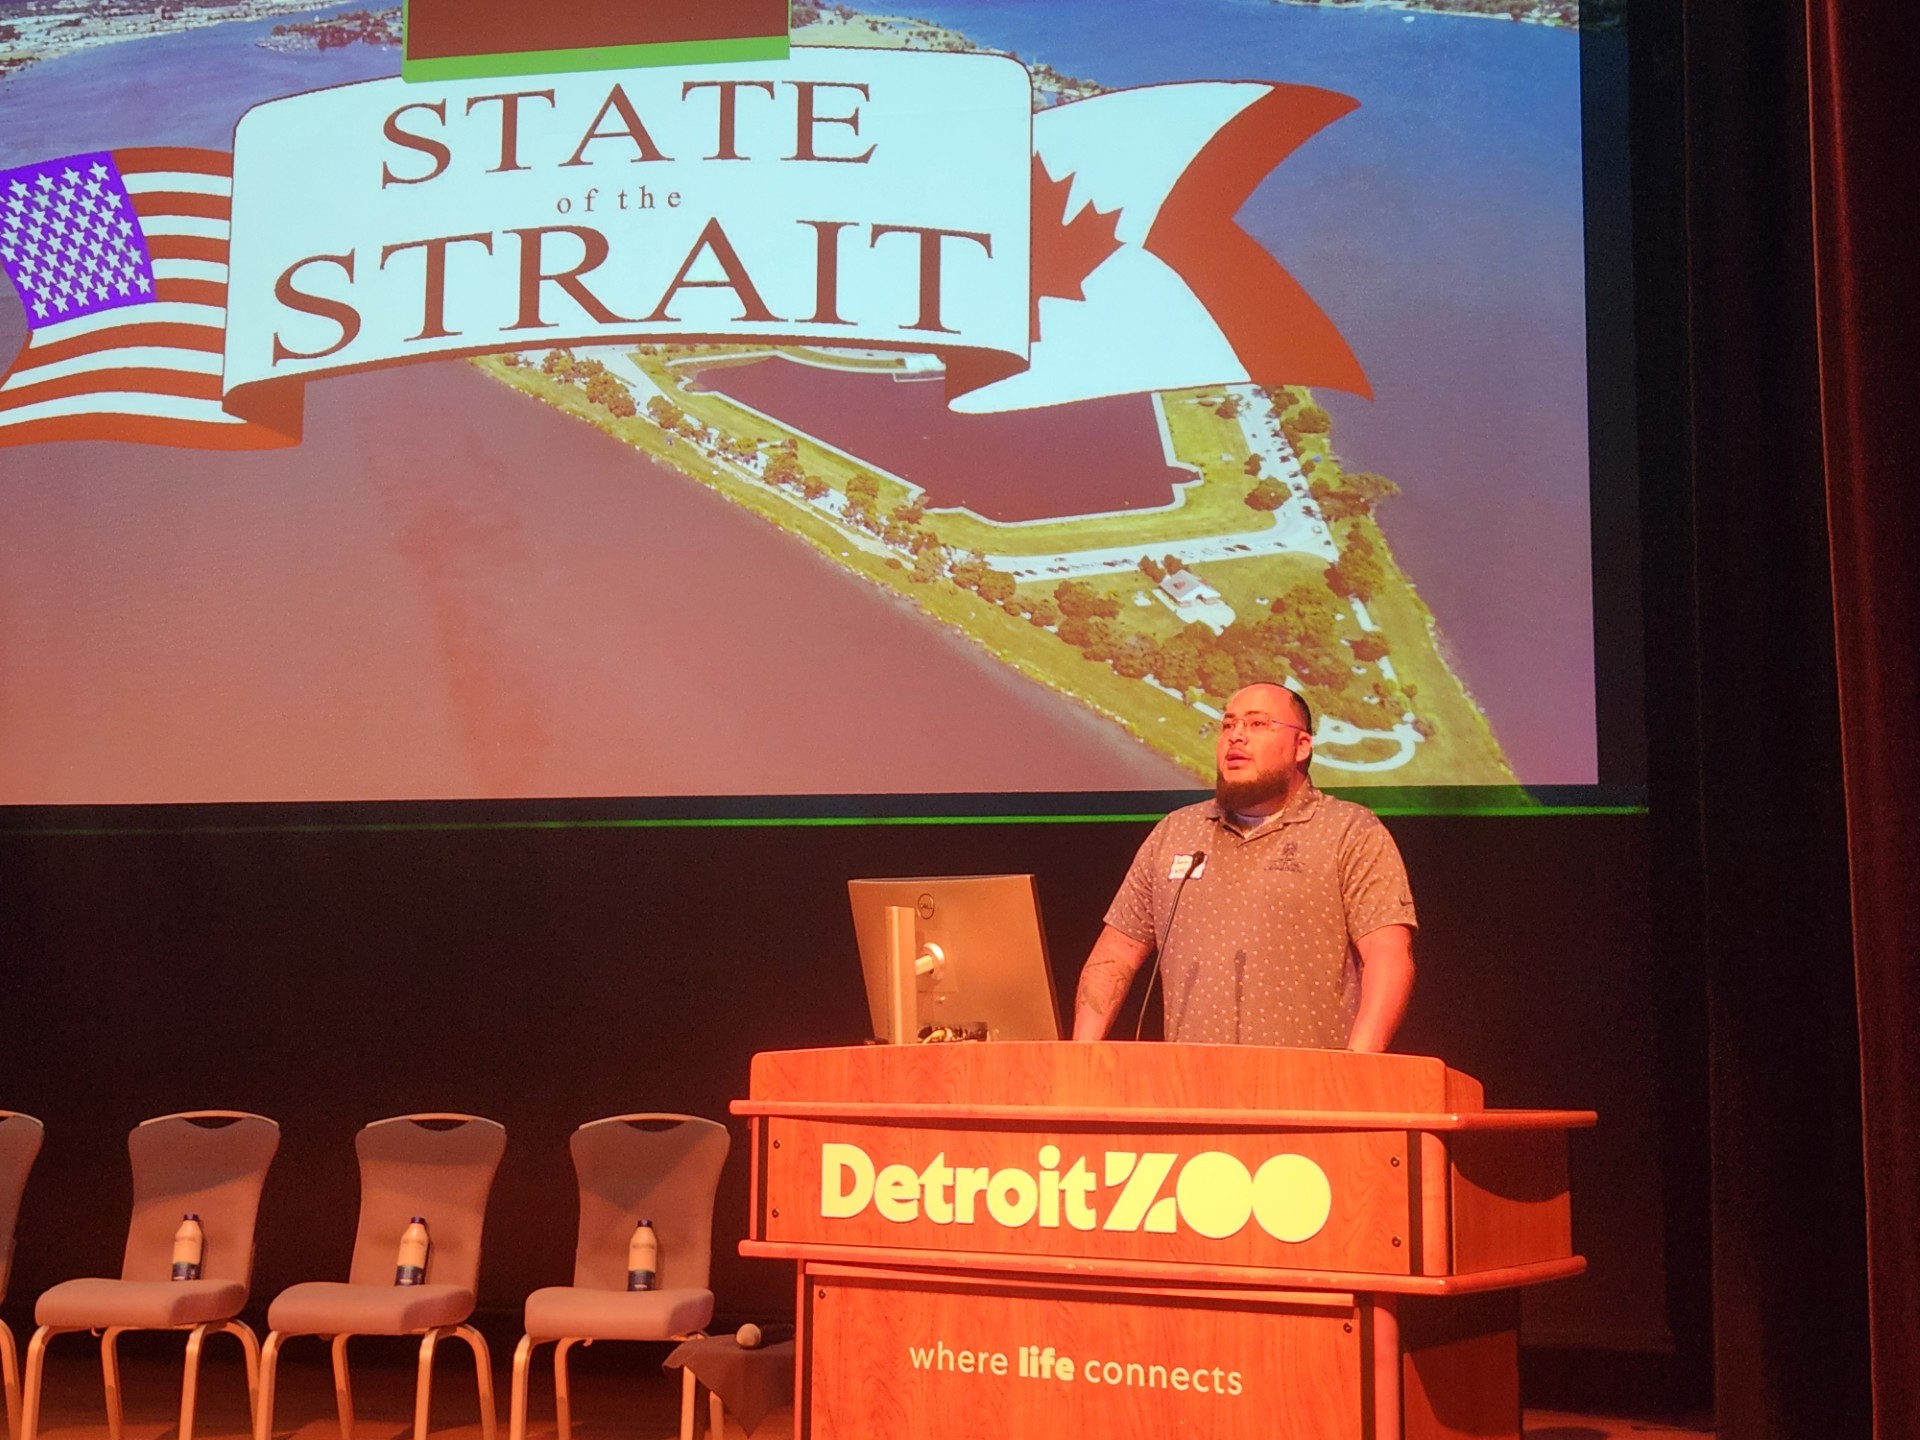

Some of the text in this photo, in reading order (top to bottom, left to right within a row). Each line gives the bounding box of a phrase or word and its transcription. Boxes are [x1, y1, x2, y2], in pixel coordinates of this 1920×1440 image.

[382, 81, 877, 190] STATE
[557, 185, 681, 215] of the
[273, 217, 993, 367] STRAIT
[909, 1340, 1243, 1396] where life connects
